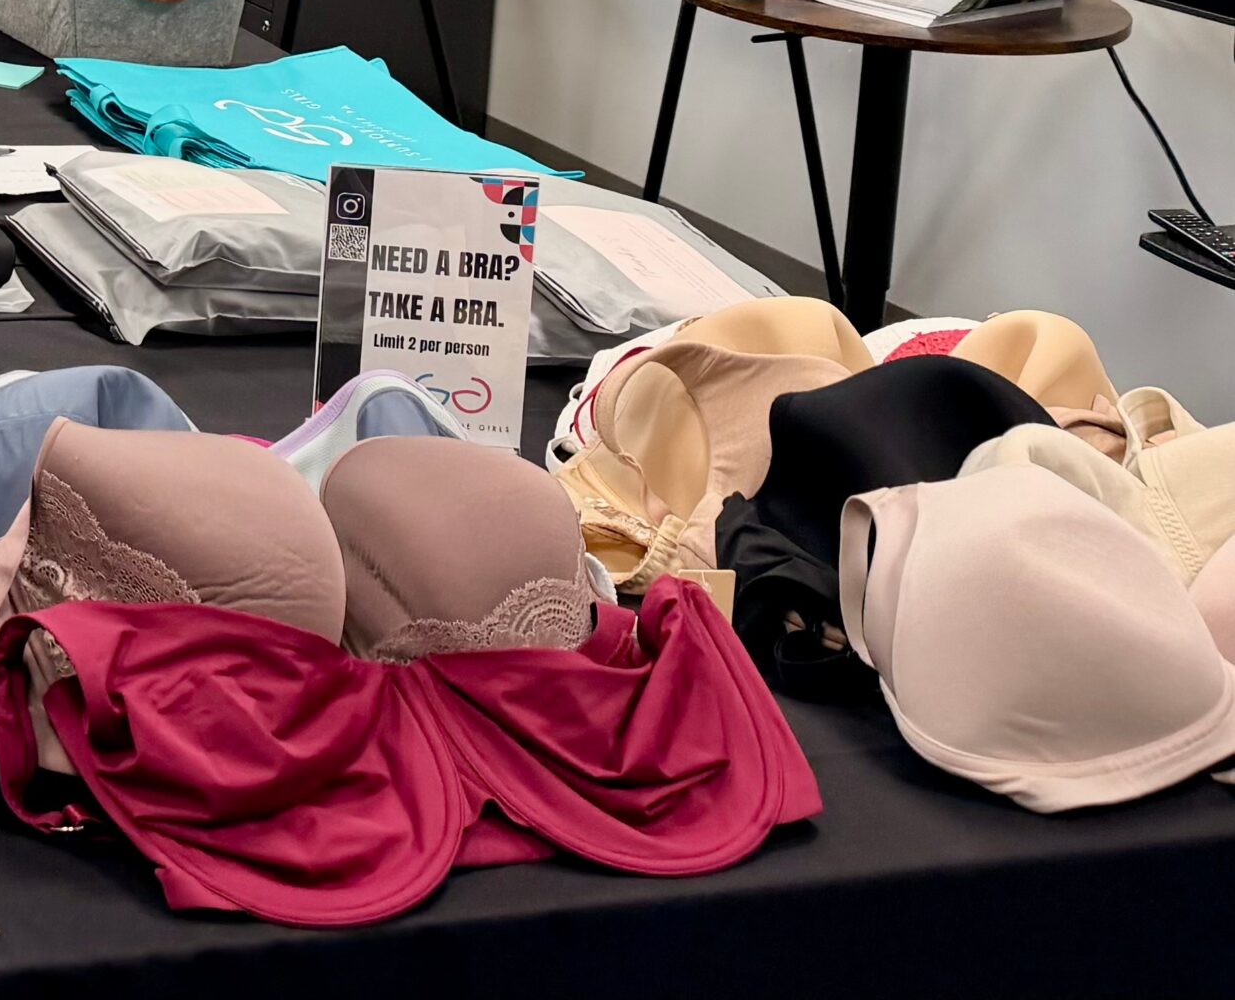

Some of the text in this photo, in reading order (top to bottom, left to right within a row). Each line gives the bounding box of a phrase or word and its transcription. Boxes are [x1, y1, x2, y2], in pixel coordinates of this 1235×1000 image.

[371, 244, 520, 281] NEED A BRA?
[368, 290, 505, 328] TAKE A BRA.
[373, 333, 490, 357] Limit 2 per person
[478, 424, 509, 433] GIRLS
